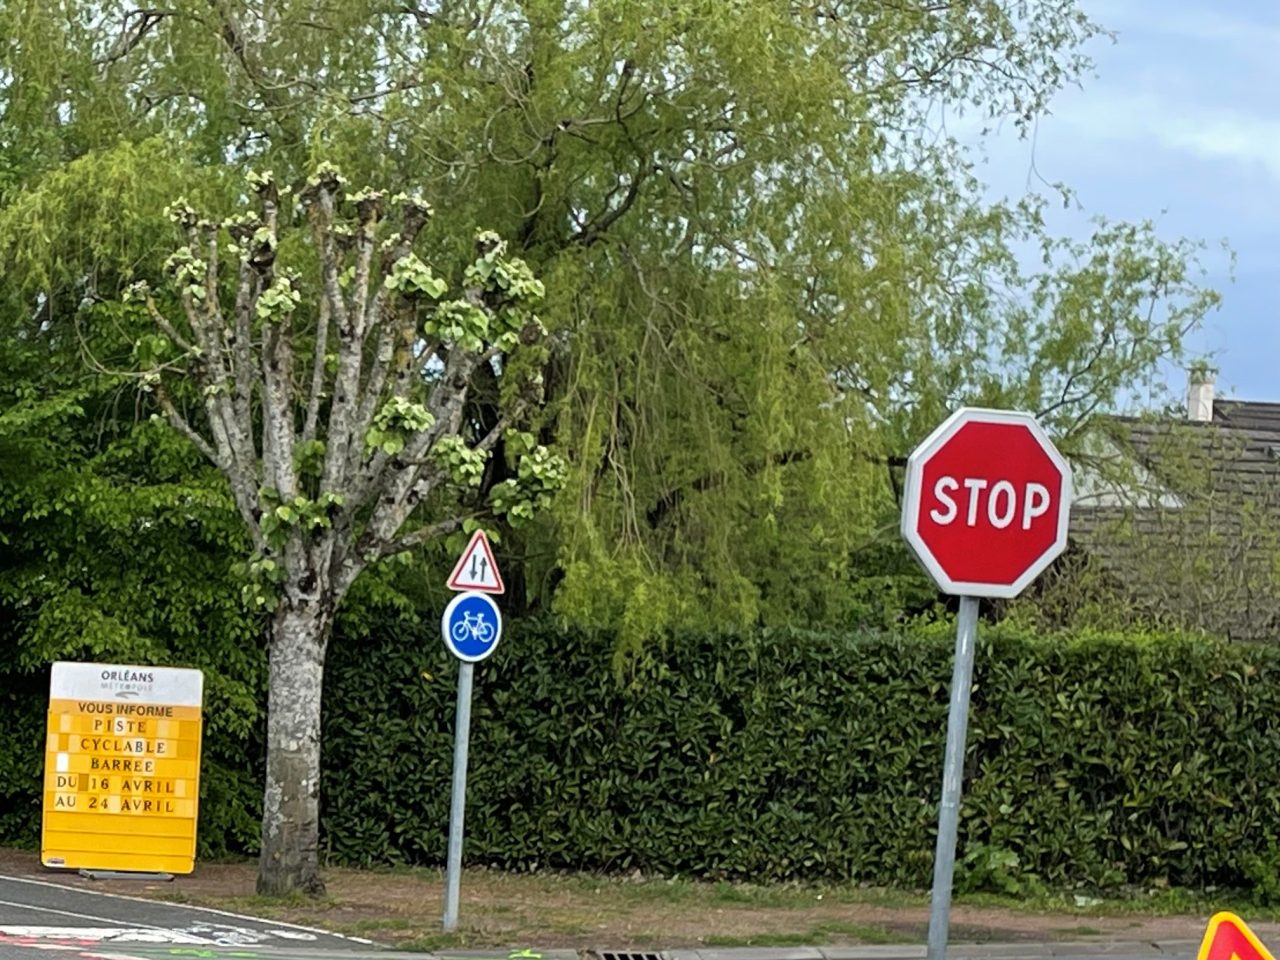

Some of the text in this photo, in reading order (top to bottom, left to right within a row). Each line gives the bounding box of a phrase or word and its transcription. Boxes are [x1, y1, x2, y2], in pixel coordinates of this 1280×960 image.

[930, 475, 1051, 530] STOP
[101, 669, 154, 683] ORLÉANS
[78, 702, 174, 718] VOUS INFORME
[94, 719, 146, 733] PISTE
[81, 738, 165, 754] CYCLABLE
[91, 758, 154, 773] BARREE
[57, 775, 174, 793] DU 16 AVRIL
[55, 795, 174, 813] AU 24 AVRIL
